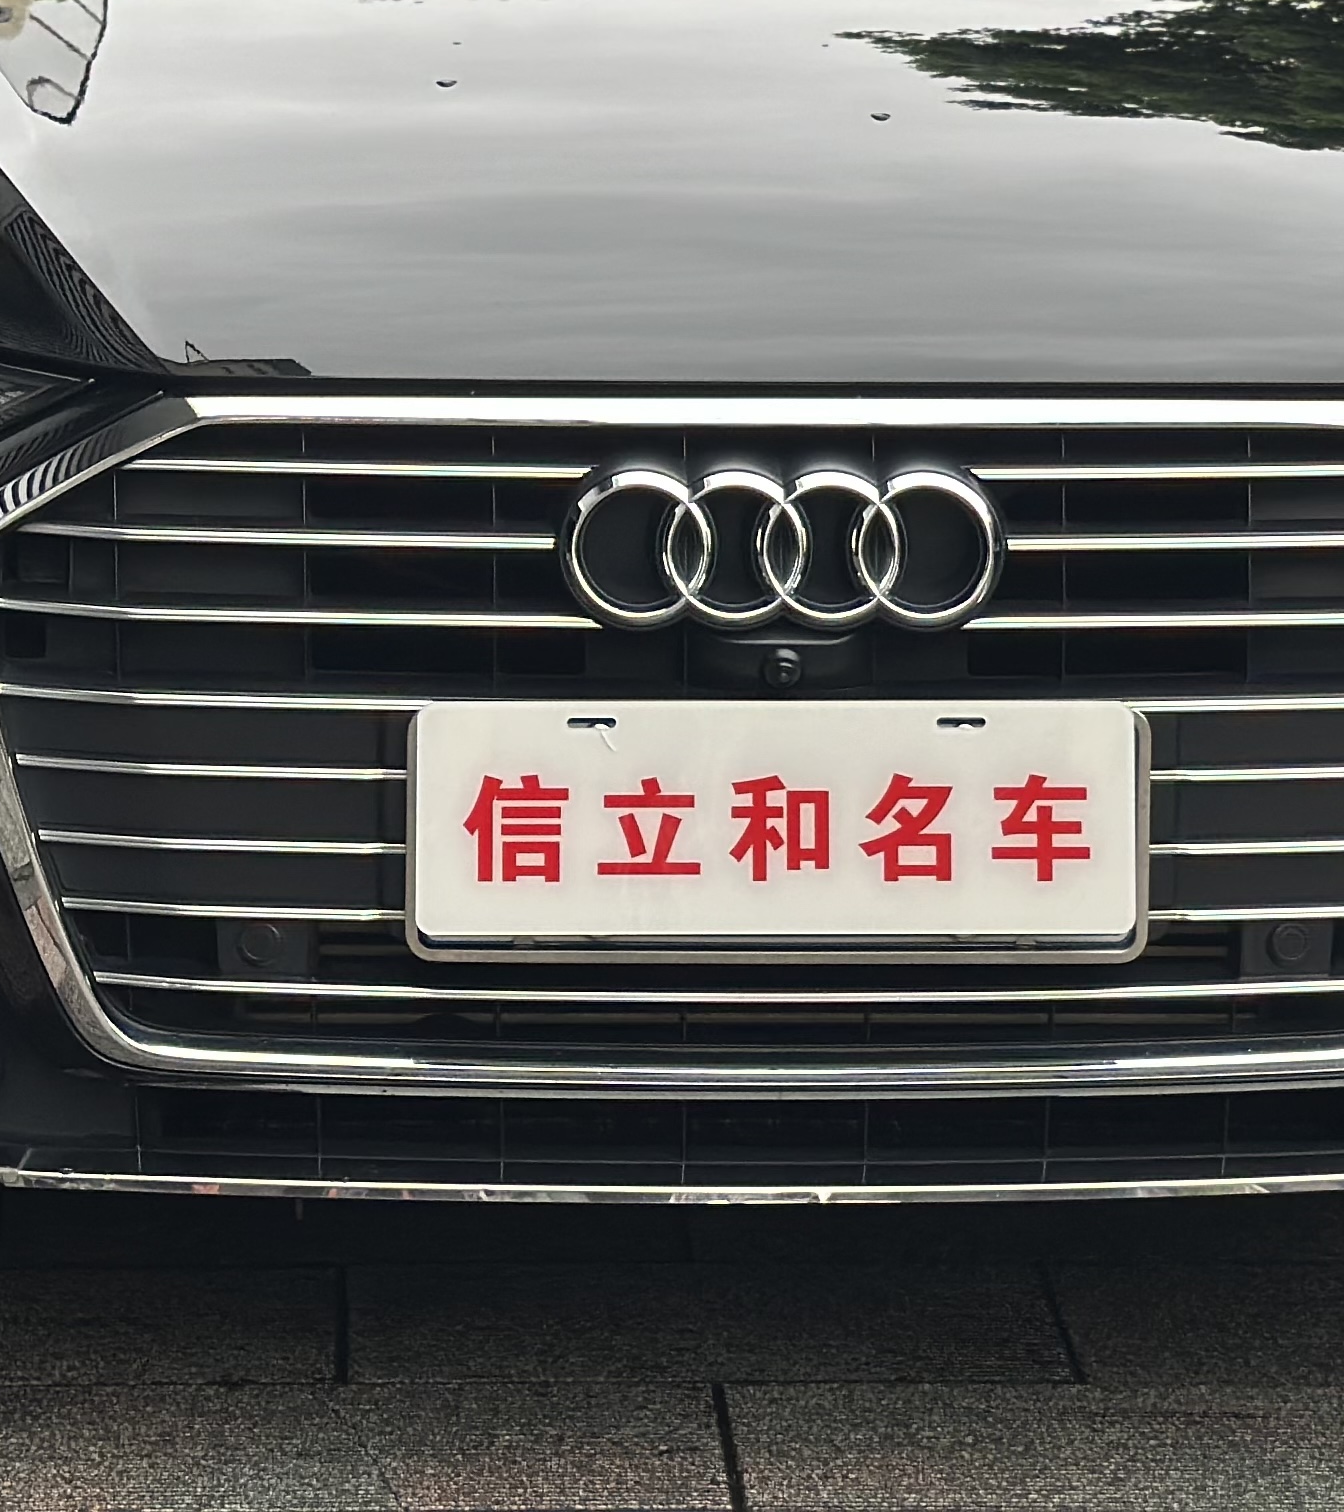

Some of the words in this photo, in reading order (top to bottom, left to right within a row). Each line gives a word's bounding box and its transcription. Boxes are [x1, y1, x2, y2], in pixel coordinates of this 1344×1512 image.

[464, 773, 1092, 883] 信立和名车
